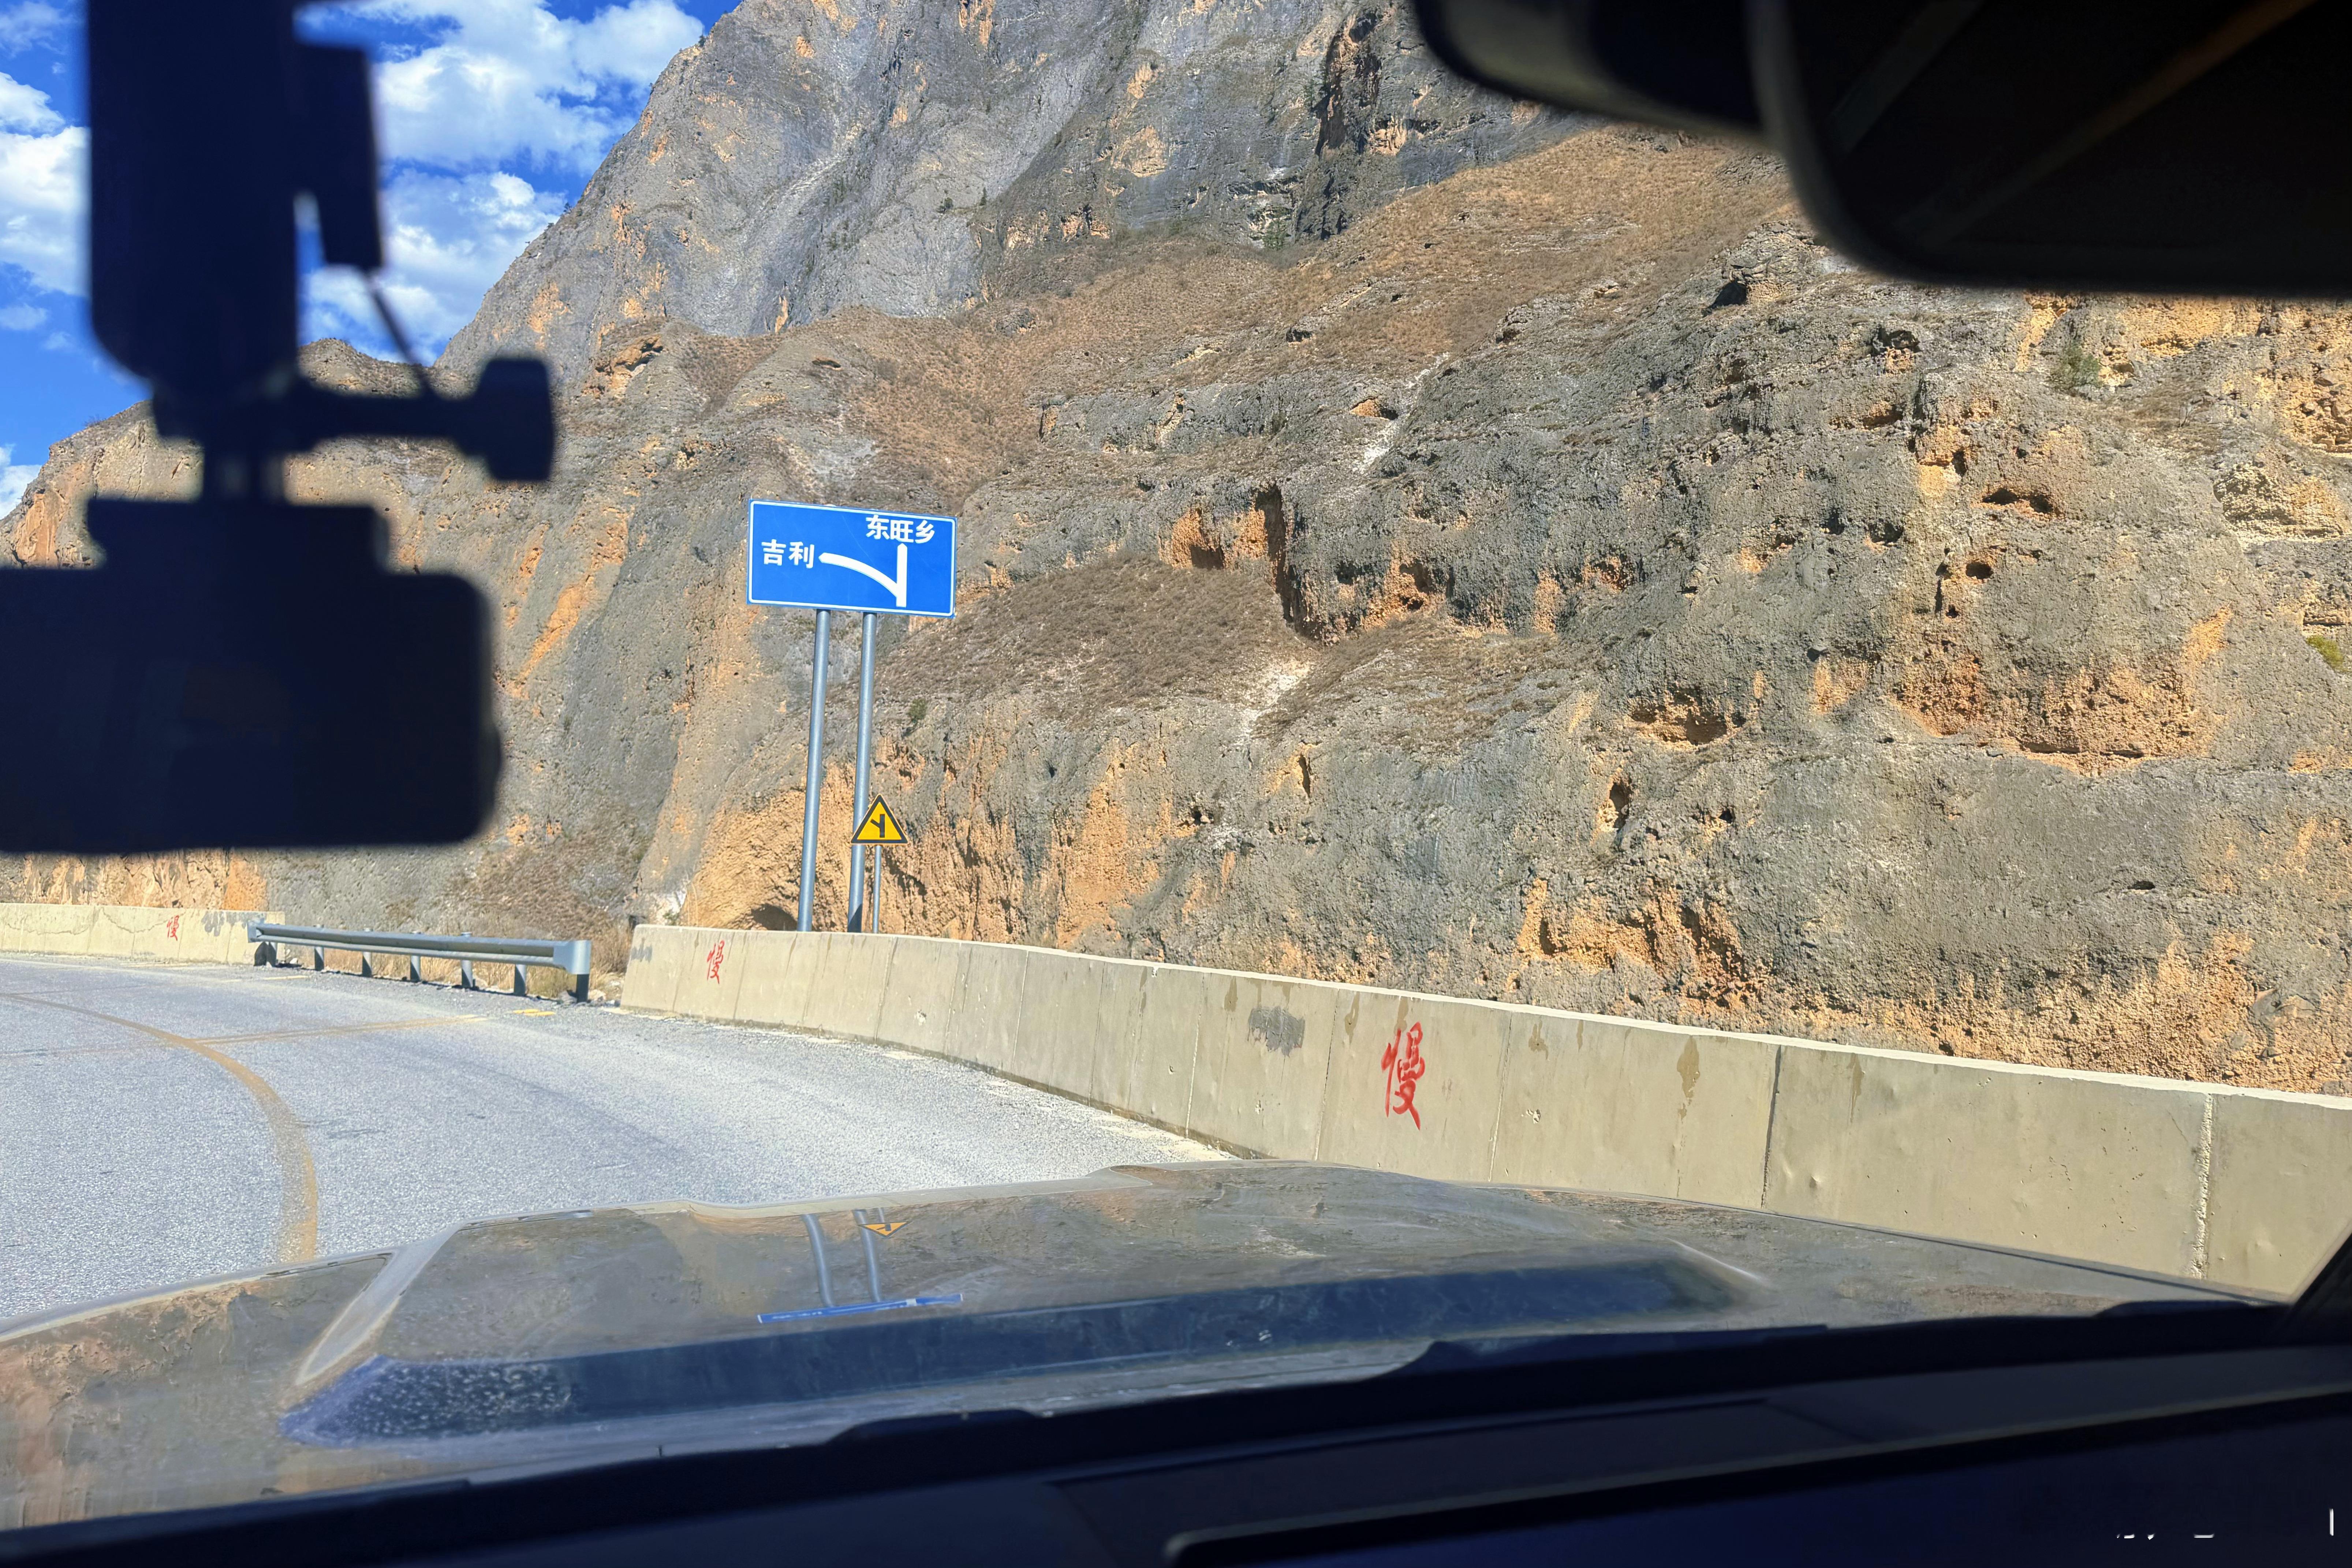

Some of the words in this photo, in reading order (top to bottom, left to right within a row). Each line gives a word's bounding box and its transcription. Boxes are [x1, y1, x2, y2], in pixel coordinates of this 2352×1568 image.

[866, 514, 935, 544] 东旺乡
[761, 539, 814, 568] 吉利
[706, 940, 725, 984] 慢
[1381, 1021, 1425, 1131] 慢
